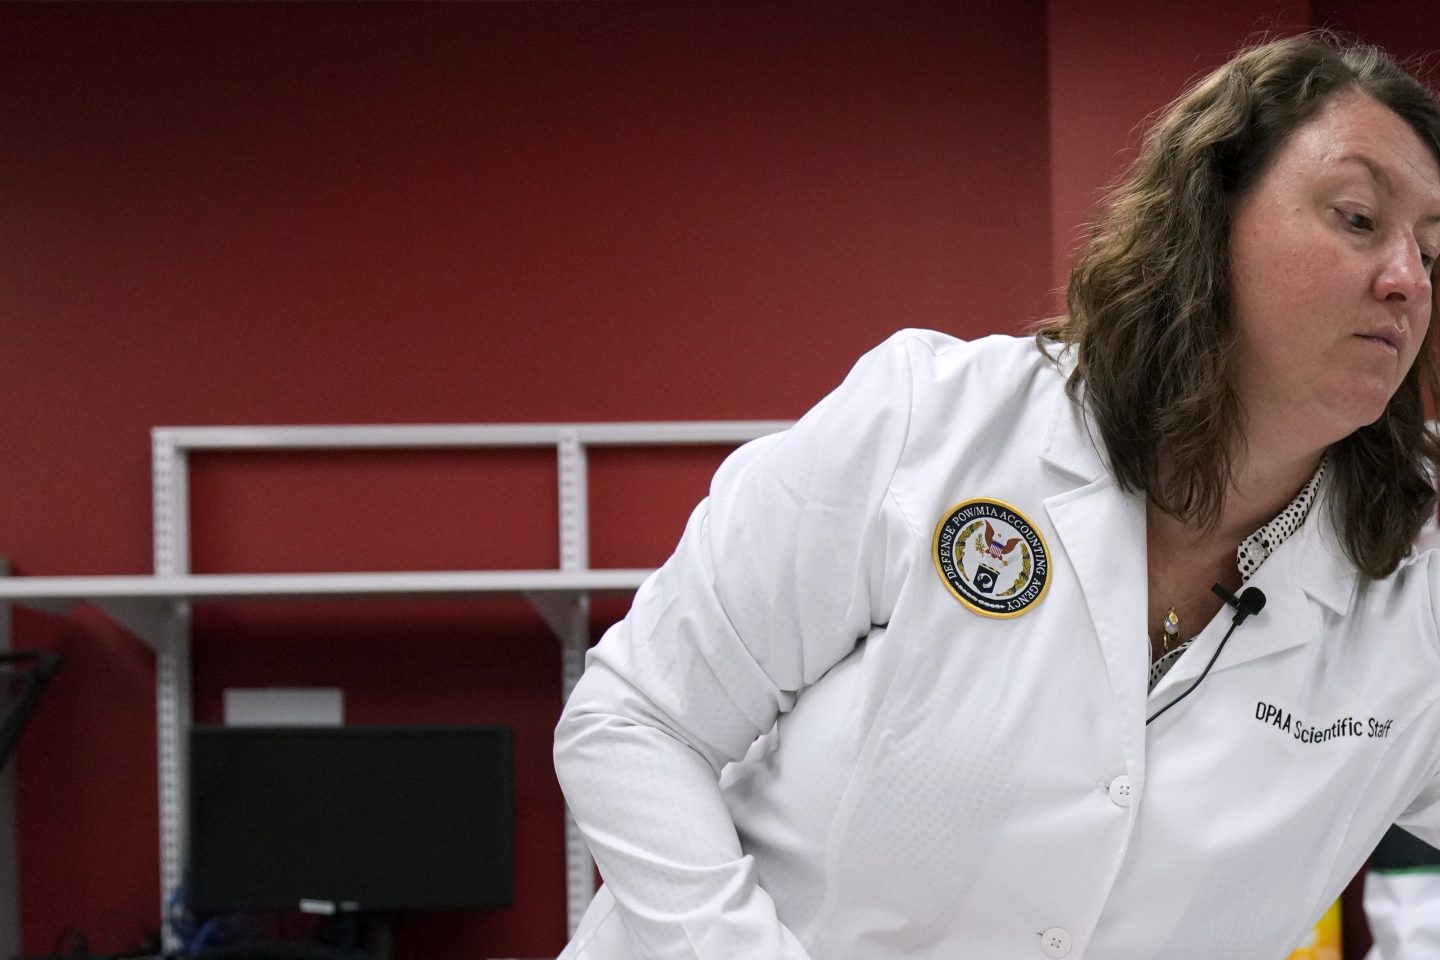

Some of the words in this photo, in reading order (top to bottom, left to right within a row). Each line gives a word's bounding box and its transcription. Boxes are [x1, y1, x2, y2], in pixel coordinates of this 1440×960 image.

[953, 506, 998, 527] POW/MIA
[941, 525, 957, 580] DEFENSE
[1000, 511, 1046, 576] ACCOUNTING
[1007, 578, 1042, 611] AGENCY
[1255, 701, 1292, 734] DPAA
[1294, 717, 1363, 744] Scientific
[1368, 717, 1394, 738] Staff
